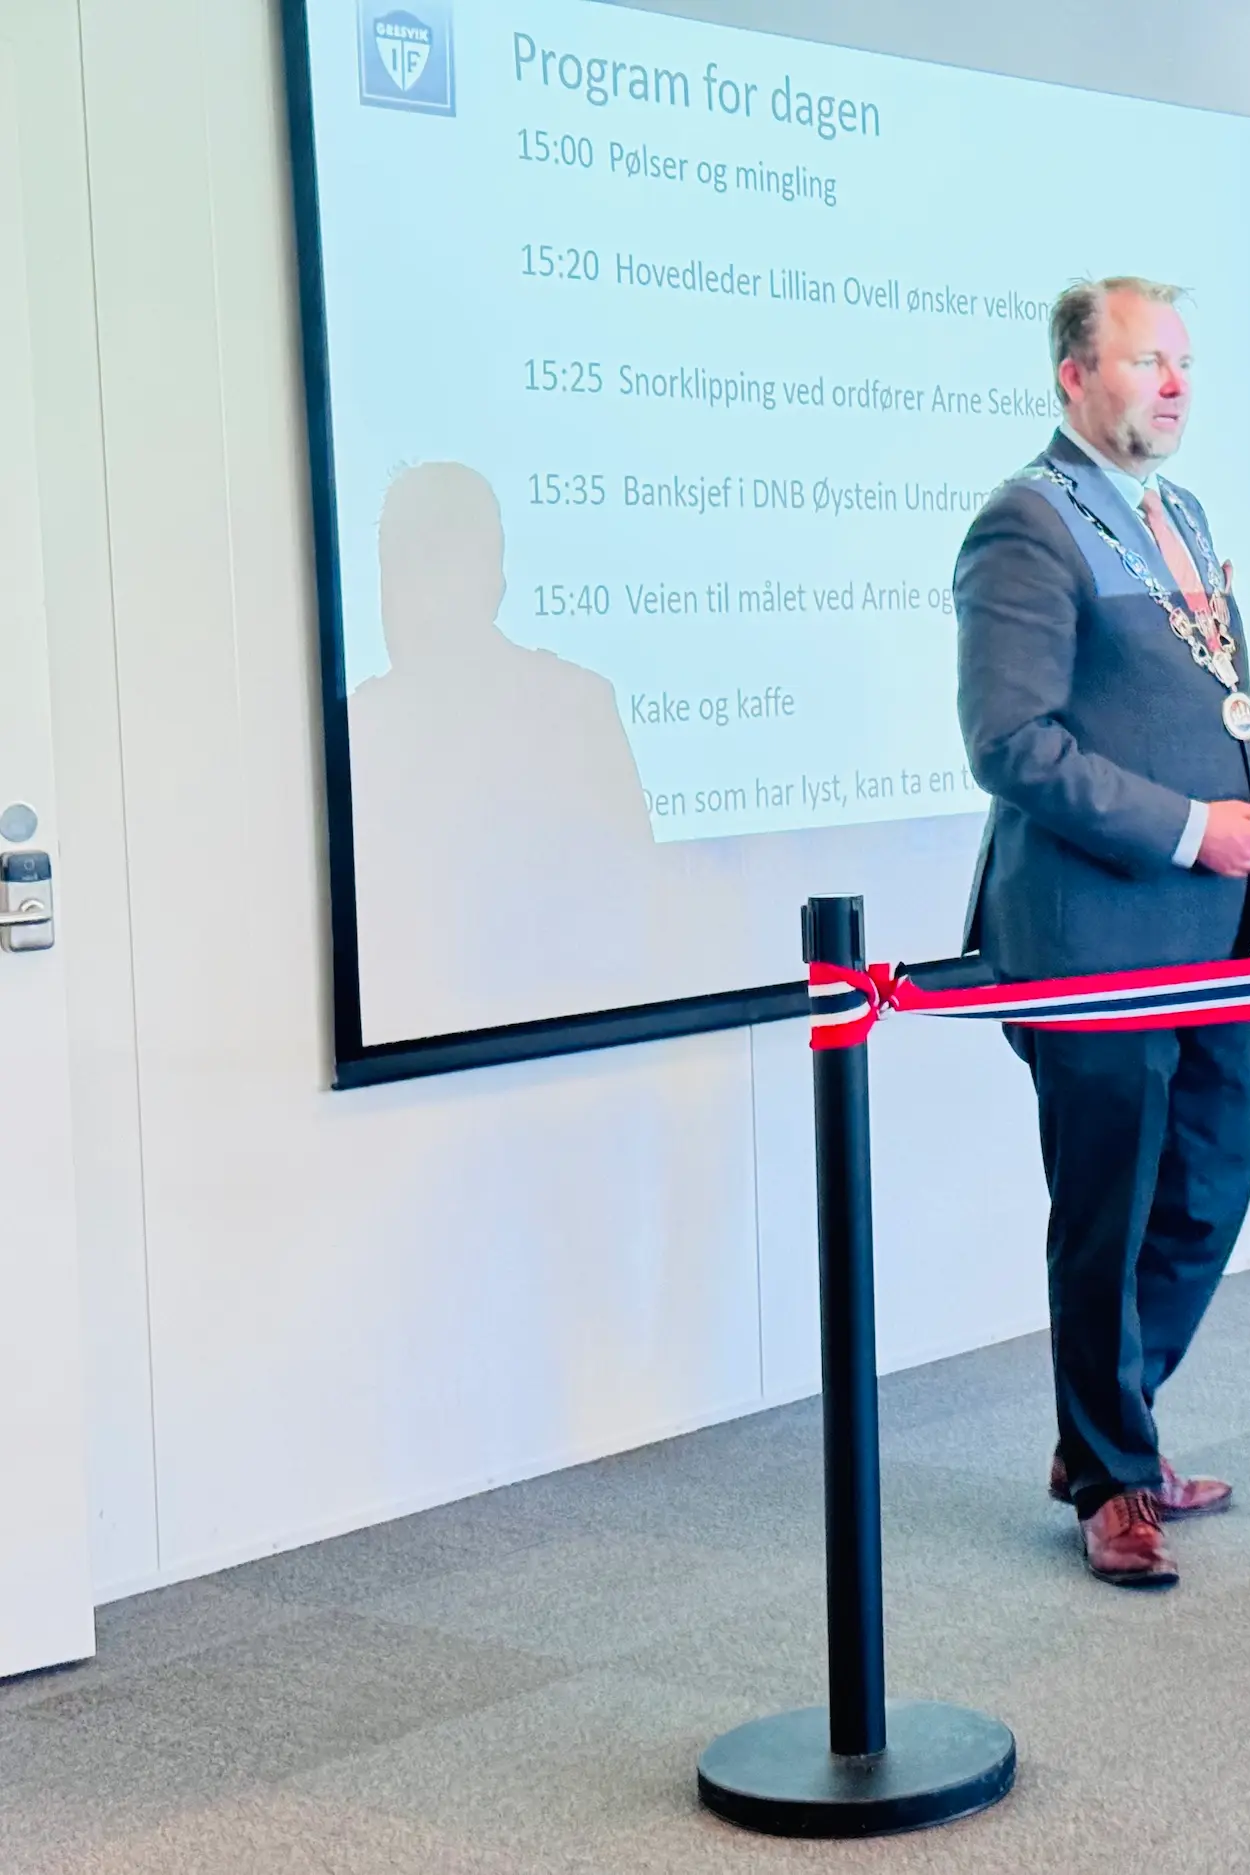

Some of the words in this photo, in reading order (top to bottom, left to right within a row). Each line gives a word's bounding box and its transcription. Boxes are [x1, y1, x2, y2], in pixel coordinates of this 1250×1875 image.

[514, 32, 689, 107] Program
[703, 63, 757, 117] for
[772, 75, 880, 140] dagen
[518, 129, 593, 168] 15:00
[610, 142, 688, 181] Pølser
[697, 161, 727, 193] og
[736, 161, 836, 207] mingling
[522, 244, 599, 281] 15:20
[617, 253, 761, 296] Hovedleder
[770, 269, 835, 303] Lillian
[844, 277, 899, 309] Ovell
[907, 285, 978, 316] ønsker
[525, 359, 602, 393] 15:25
[620, 365, 776, 410] Snorklipping
[783, 376, 824, 406] ved
[832, 379, 924, 411] ordfører
[932, 385, 981, 413] Arne
[529, 473, 605, 505] 15:35
[624, 475, 731, 514] Banksjef
[738, 477, 745, 508] i
[754, 479, 804, 508] DNB
[813, 478, 897, 517] Øystein
[535, 585, 610, 616] 15:40
[625, 583, 697, 614] Veien
[706, 582, 729, 613] til
[742, 580, 806, 612] målet
[813, 581, 853, 611] ved
[862, 580, 920, 610] Arnie
[928, 587, 953, 615] og
[632, 692, 690, 724] Kake
[699, 698, 729, 726] og
[737, 686, 794, 718] kaffe
[695, 789, 746, 813] som
[756, 778, 794, 808] har
[802, 775, 847, 811] lyst,
[856, 770, 893, 799] kan
[901, 769, 921, 795] ta
[929, 771, 954, 792] en
